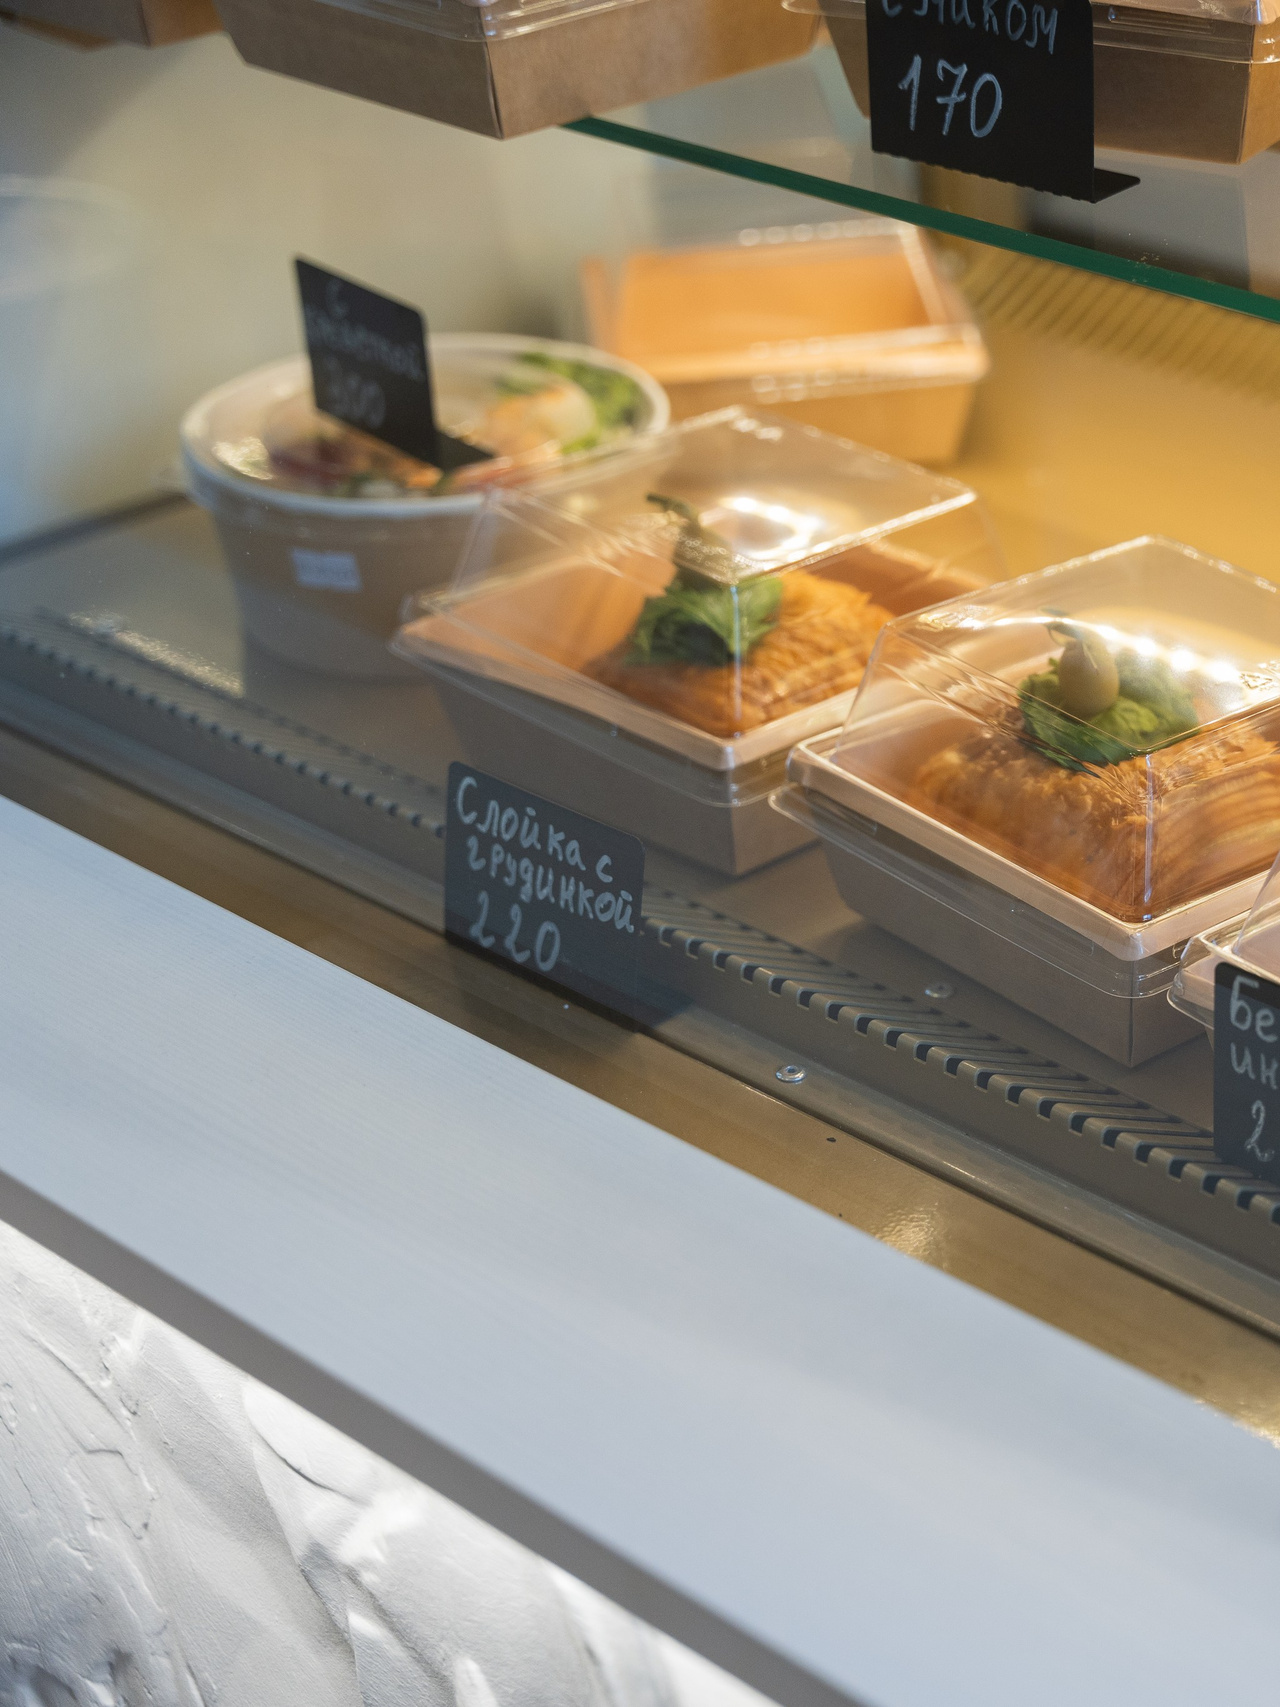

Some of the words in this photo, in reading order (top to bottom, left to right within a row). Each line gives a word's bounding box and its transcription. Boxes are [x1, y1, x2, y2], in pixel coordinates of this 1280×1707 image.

[898, 54, 1002, 138] 170
[456, 776, 587, 871] Слойка
[470, 890, 561, 972] 220
